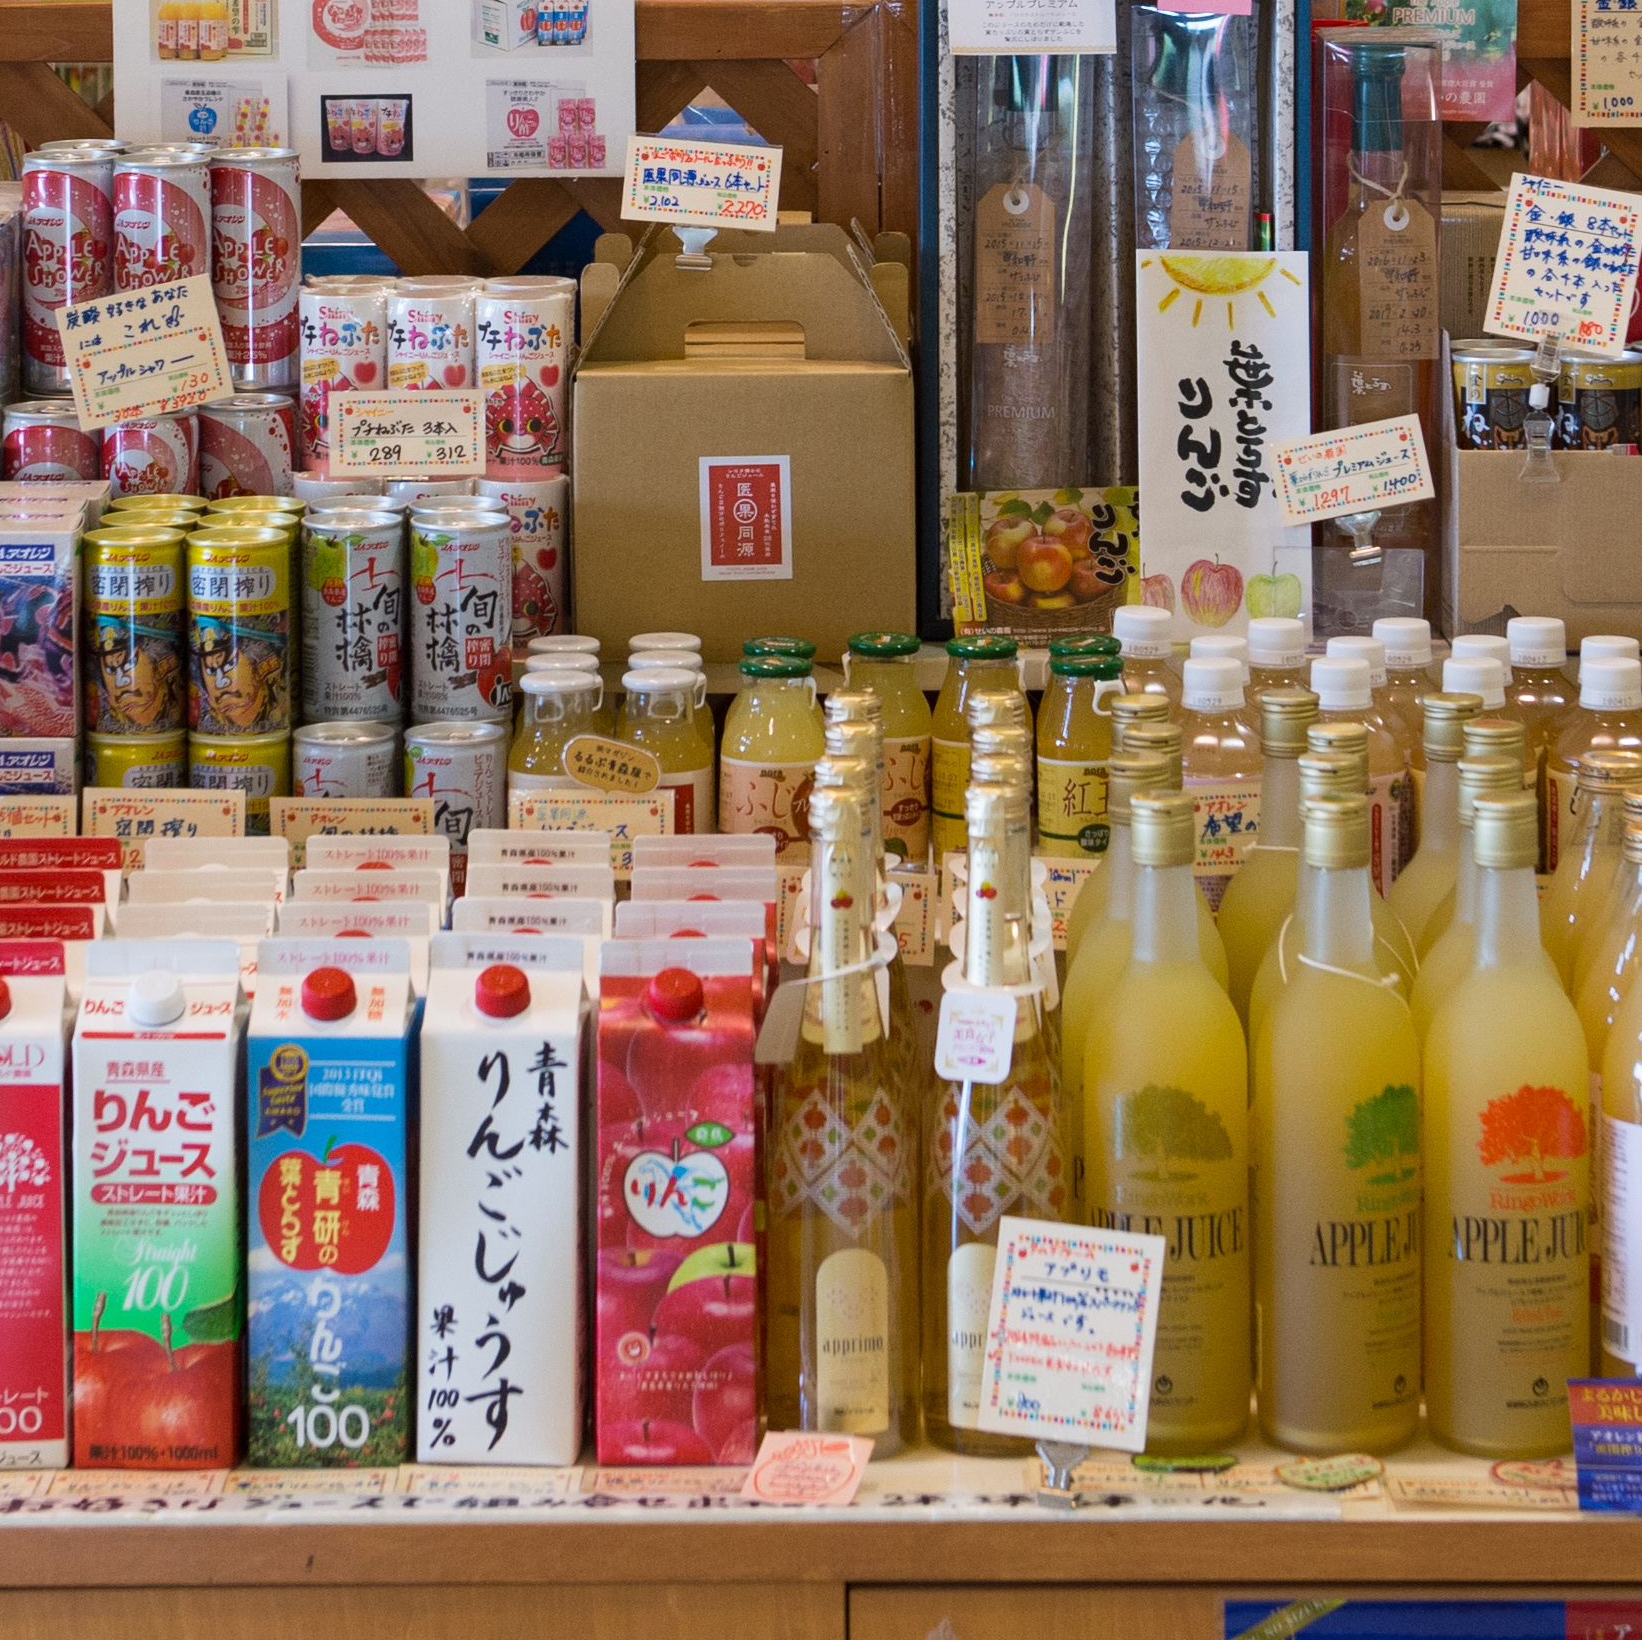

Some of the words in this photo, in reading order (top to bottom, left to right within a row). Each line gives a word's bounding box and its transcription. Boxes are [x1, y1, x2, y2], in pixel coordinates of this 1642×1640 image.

[1393, 10, 1476, 25] PREMIUM
[318, 305, 354, 324] Shiny
[479, 320, 561, 351] プチねぶた
[369, 445, 403, 462] 289
[435, 443, 467, 459] 312
[732, 481, 759, 558] 医果同源
[89, 573, 172, 599] 密閉搾り
[191, 573, 272, 599] 密閉搾り
[84, 998, 125, 1016] りんご
[190, 1000, 232, 1016] ジュース
[106, 1060, 166, 1079] 青森県産
[92, 1090, 217, 1132] りんご
[525, 1040, 569, 1155] 青森
[90, 1141, 216, 1179] ジュース
[99, 1185, 207, 1204] ストレート果汁
[355, 1163, 380, 1213] 青森
[277, 1157, 303, 1264] 葉とらず
[312, 1168, 342, 1266] 青研の
[462, 1048, 526, 1453] りんごじゅうす
[1309, 1219, 1402, 1267] APPLE
[122, 1266, 189, 1312] 100
[426, 1303, 460, 1451] 果汁100%
[287, 1404, 370, 1449] 100
